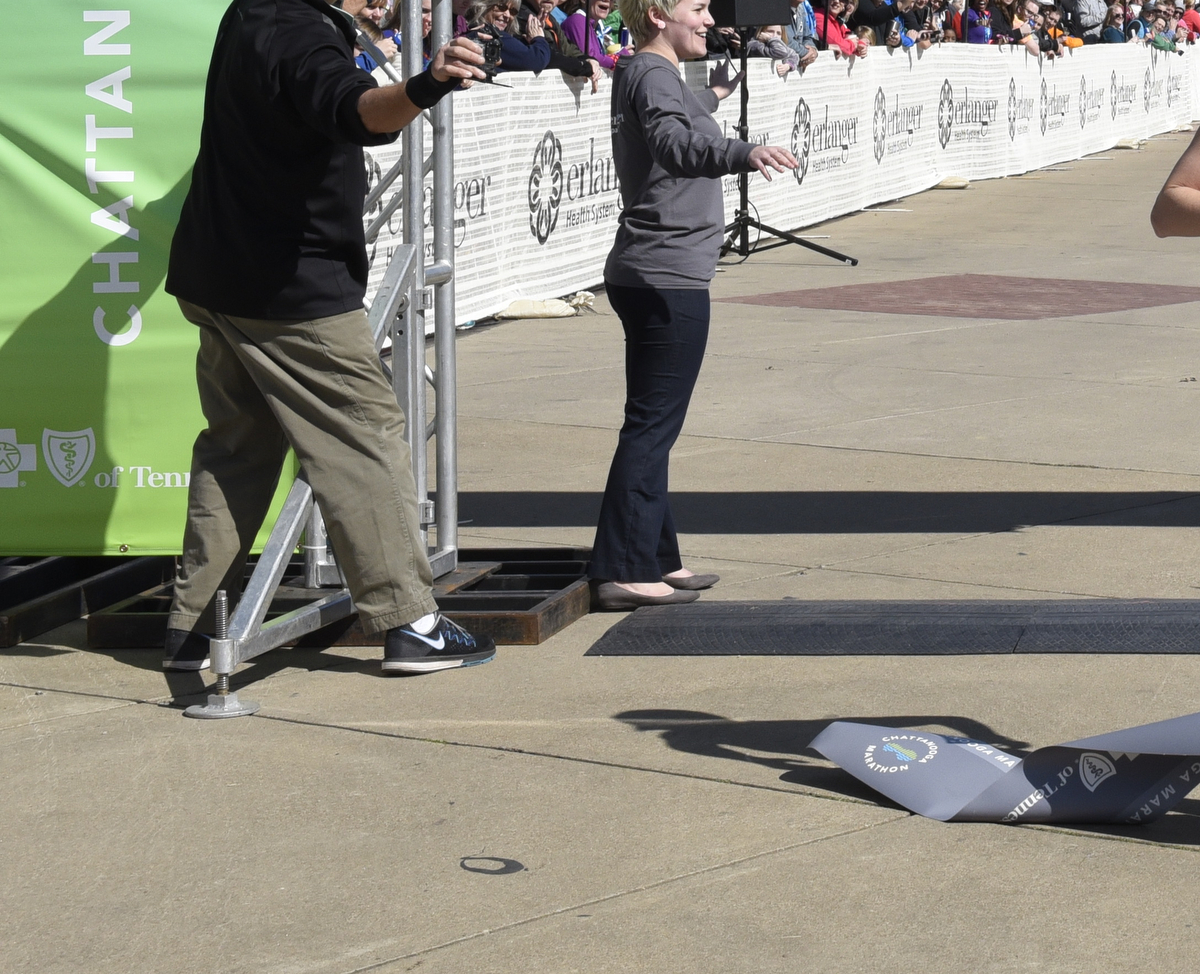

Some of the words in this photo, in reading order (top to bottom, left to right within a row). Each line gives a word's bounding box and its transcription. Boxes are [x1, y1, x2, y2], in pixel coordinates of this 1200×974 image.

[887, 93, 924, 147] erlanger
[954, 86, 999, 137] erlanger
[812, 104, 859, 164] erlanger
[566, 206, 590, 227] Health
[591, 202, 616, 221] System
[94, 465, 125, 488] of
[864, 744, 909, 774] MARATHON
[882, 735, 938, 764] CHATTANOOGA
